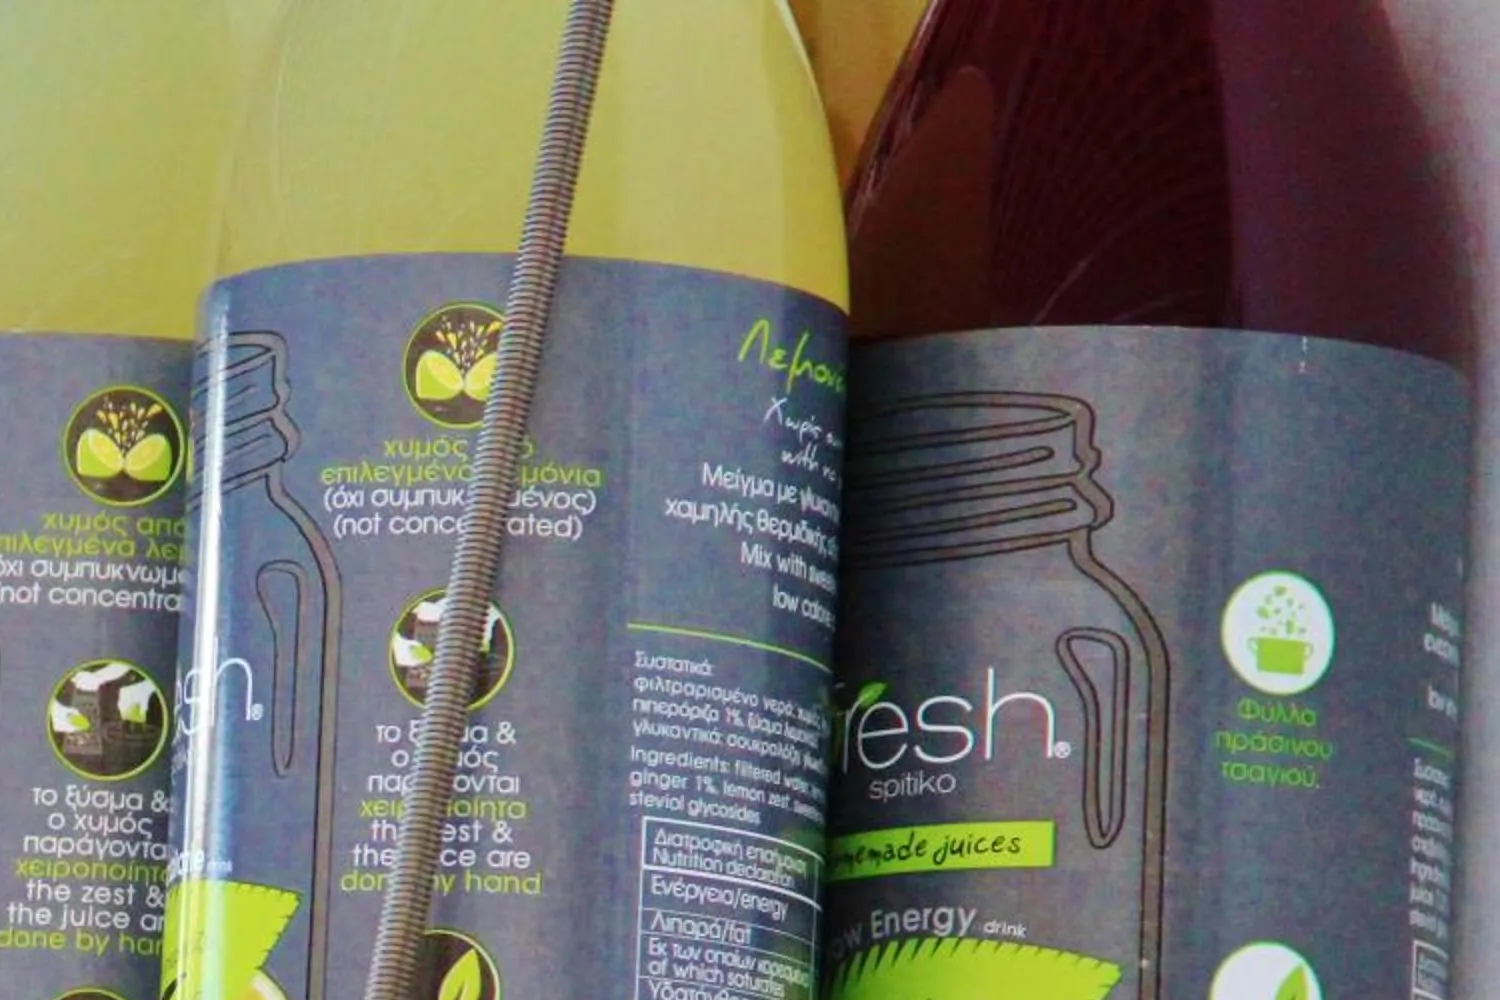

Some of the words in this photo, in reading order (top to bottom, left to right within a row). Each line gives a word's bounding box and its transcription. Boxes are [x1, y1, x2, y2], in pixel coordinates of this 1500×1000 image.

[384, 436, 468, 461] χυμός
[701, 461, 775, 499] Μείγμα
[777, 481, 798, 504] με
[324, 486, 364, 511] (όχι
[42, 511, 127, 537] χυμός
[333, 513, 381, 539] (not
[664, 497, 755, 535] χαμηλής
[741, 540, 772, 569] Mix
[773, 582, 799, 612] low
[375, 724, 401, 744] το
[496, 721, 517, 744] &
[1214, 729, 1335, 762] πράσινου
[629, 767, 688, 791] ginger
[869, 769, 958, 803] spitiko
[32, 786, 59, 807] το
[64, 784, 144, 813] ξύσμα
[151, 790, 174, 813] &
[73, 811, 153, 839] χυμός
[492, 820, 513, 842] &
[486, 848, 532, 870] are
[652, 846, 723, 875] Nutrition
[932, 833, 1023, 866] juices
[26, 877, 71, 902] the
[81, 882, 137, 906] zest
[145, 884, 166, 909] &
[464, 871, 543, 895] hand
[6, 901, 52, 926] the
[59, 904, 132, 931] juice
[870, 904, 978, 940] Energy
[984, 919, 1028, 939] drink
[75, 930, 111, 956] by
[647, 958, 668, 978] of
[672, 960, 725, 984] which
